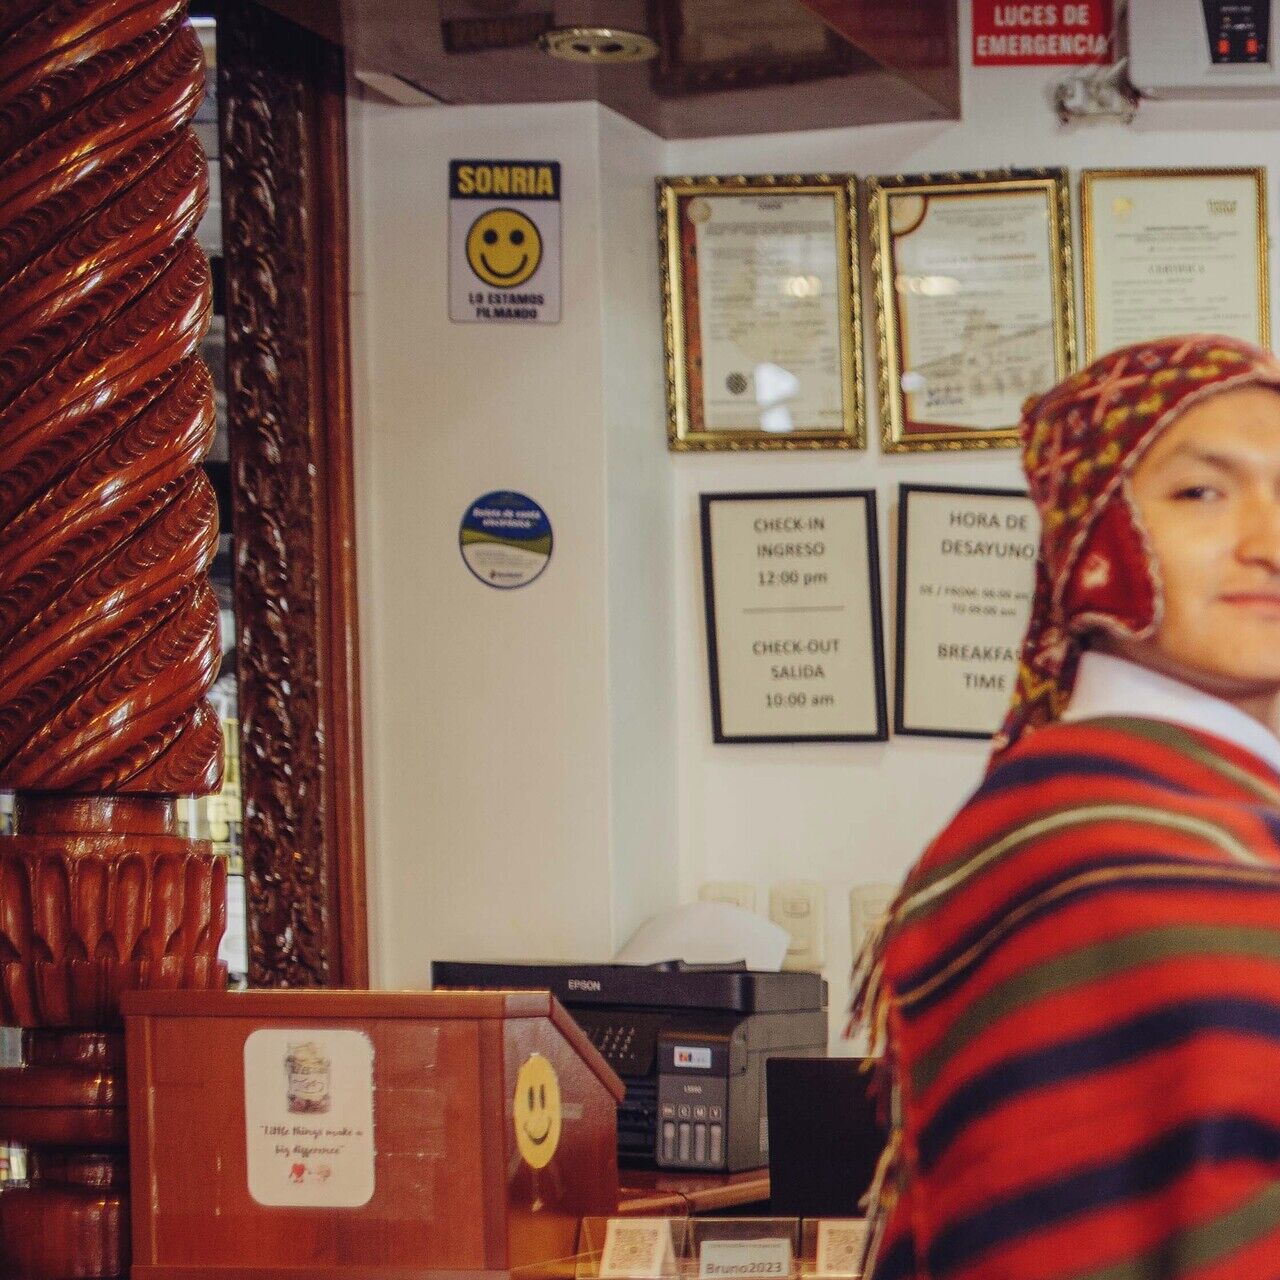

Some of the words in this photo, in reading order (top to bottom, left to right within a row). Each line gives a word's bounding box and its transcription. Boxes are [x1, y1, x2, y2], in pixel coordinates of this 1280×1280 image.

[993, 4, 1057, 26] LUCES
[1063, 4, 1090, 26] DE
[976, 33, 1108, 56] EMERGENCIA
[457, 165, 555, 195] SONRIA
[469, 292, 484, 304] LO
[488, 292, 545, 305] ESTAMOS
[476, 307, 537, 319] FILMANDO
[950, 510, 1000, 529] HORA
[1005, 513, 1029, 531] DE
[756, 541, 826, 559] INGRESO
[940, 538, 1035, 560] DESAYUNO
[759, 570, 799, 587] 12:00
[803, 572, 828, 587] pm
[752, 637, 841, 656] CHECK-OUT
[771, 664, 826, 681] SALIDA
[964, 672, 1007, 691] TIME
[766, 692, 807, 709] 10:00
[811, 693, 834, 707] am
[568, 979, 601, 992] EPSON
[326, 1127, 353, 1137] make
[275, 1144, 290, 1158] big
[705, 1262, 782, 1274] Bruno2023
